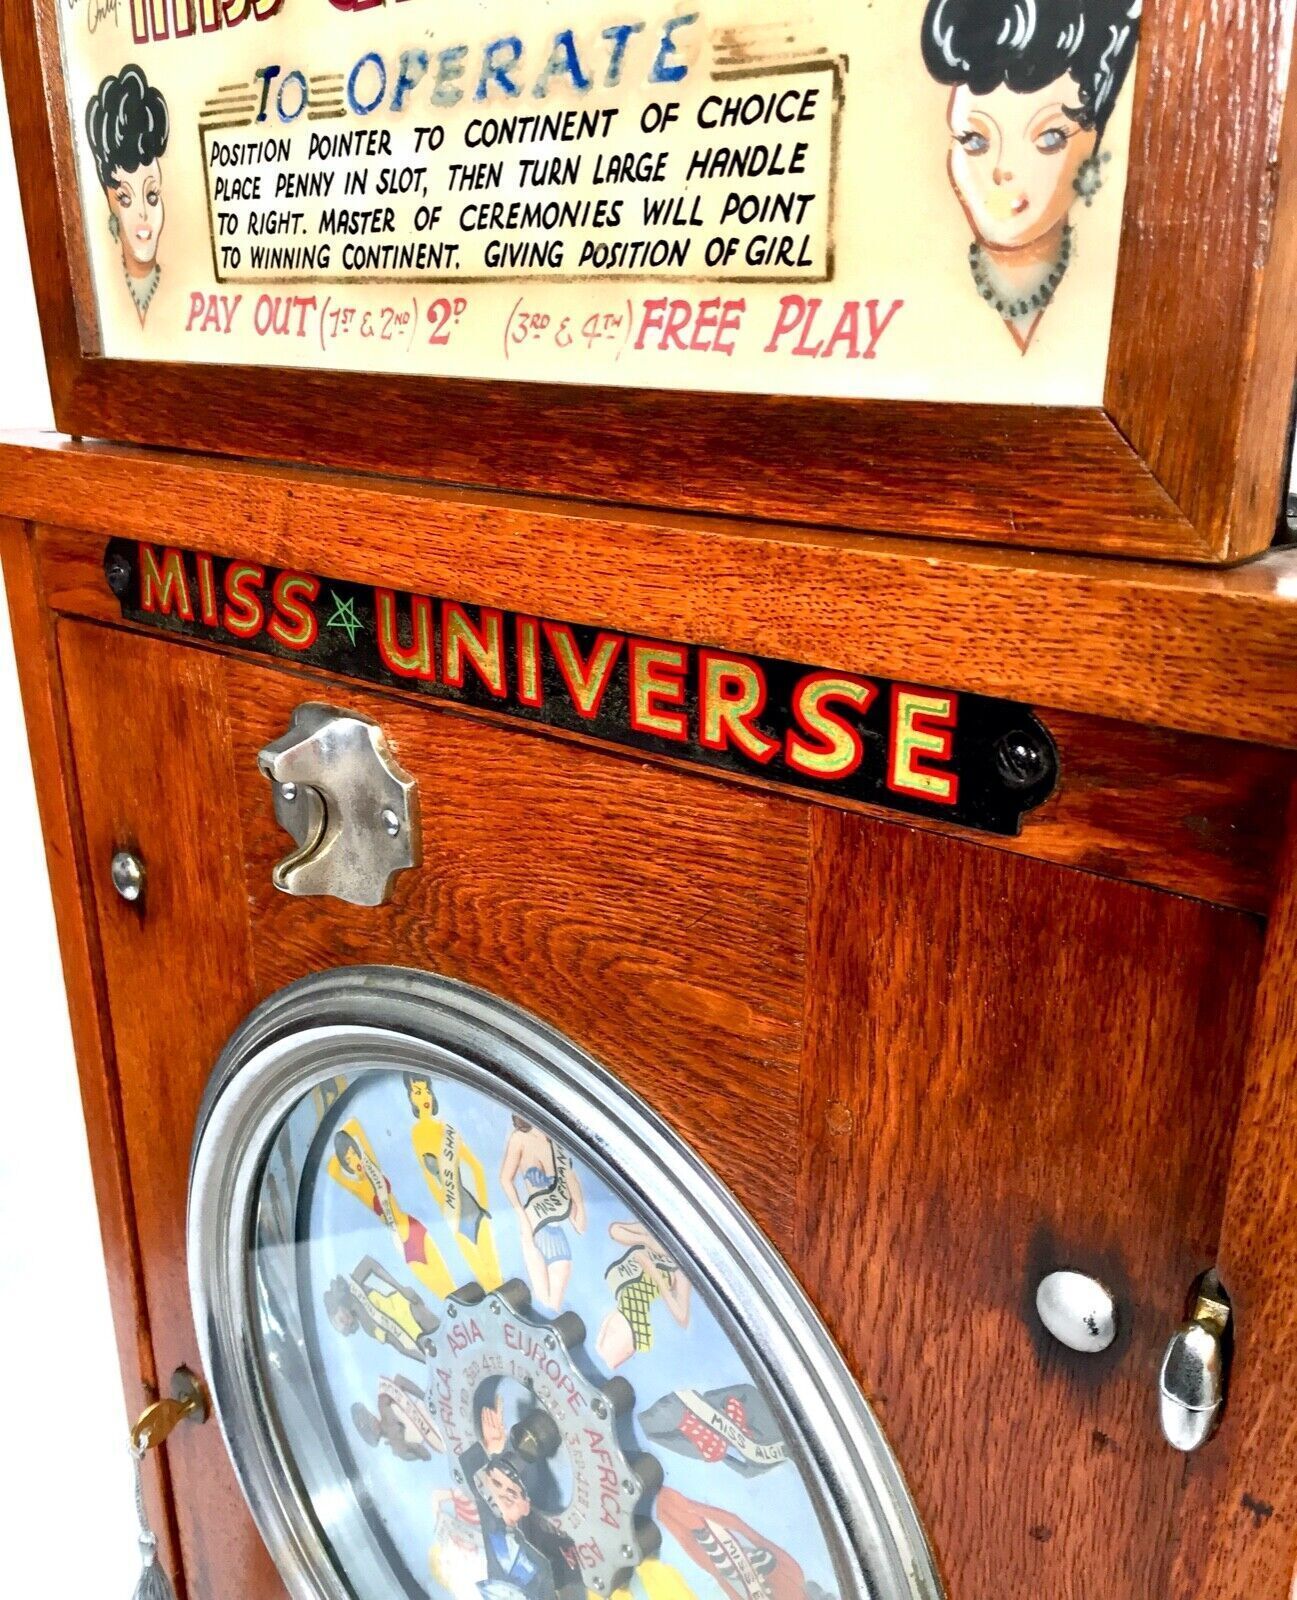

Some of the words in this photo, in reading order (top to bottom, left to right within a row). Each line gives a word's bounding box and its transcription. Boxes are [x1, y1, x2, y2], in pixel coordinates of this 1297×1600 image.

[255, 65, 309, 125] TO
[346, 13, 701, 117] OPERATE
[209, 138, 292, 168] POSITION
[308, 129, 393, 161] POINTER
[414, 125, 445, 153] TO
[464, 108, 619, 149] CONTINENT
[640, 102, 680, 133] OF
[697, 88, 820, 129] CHOICE
[214, 176, 261, 202] PLACE
[275, 171, 335, 198] PENNY
[344, 168, 368, 195] IN
[376, 166, 428, 198] SLOT,
[448, 161, 504, 192] THEN
[519, 154, 581, 188] TURN
[592, 152, 669, 185] LARGE
[685, 142, 809, 181] HANDLE
[217, 212, 239, 236] TO
[247, 210, 308, 236] RIGHT.
[318, 207, 395, 236] MASTER
[414, 205, 443, 232] OF
[458, 199, 625, 232] CEREMONIES
[643, 195, 704, 227] WILL
[719, 192, 816, 225] POINT
[221, 245, 242, 270] TO
[250, 244, 331, 270] WINNING
[342, 241, 461, 270] CONTINENT.
[484, 240, 564, 269] GIVING
[578, 238, 691, 270] POSITION
[704, 236, 740, 267] OF
[745, 234, 814, 267] GIRL
[184, 291, 242, 334] PAY
[253, 294, 318, 337] OUT
[360, 311, 375, 338] &
[554, 315, 573, 349] &
[633, 297, 746, 357] FREE
[764, 294, 904, 360] PLAY
[138, 541, 323, 653] MISS
[374, 590, 960, 806] UNIVERSE
[443, 1168, 456, 1210] MISS
[533, 1194, 563, 1219] MISS
[445, 1318, 485, 1358] ASIA
[503, 1322, 588, 1417] EUROPE
[710, 1413, 747, 1449] MISS
[583, 1428, 621, 1530] AFRICA
[722, 1539, 756, 1585] MISS
